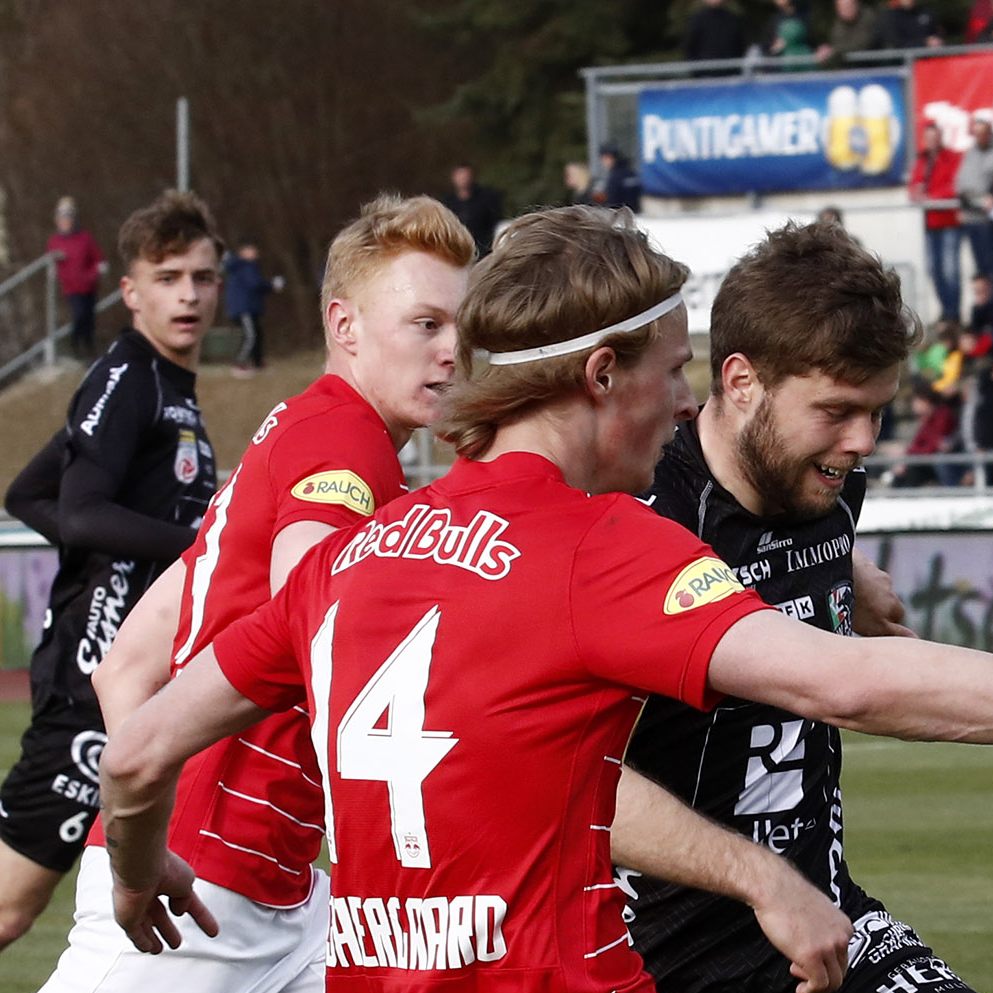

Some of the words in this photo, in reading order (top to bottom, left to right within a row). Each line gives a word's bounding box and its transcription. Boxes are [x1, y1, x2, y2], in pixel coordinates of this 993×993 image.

[641, 107, 821, 163] PUNTIGAMER
[316, 480, 371, 511] RAUCH
[310, 599, 460, 869] 14
[59, 811, 89, 843] 6
